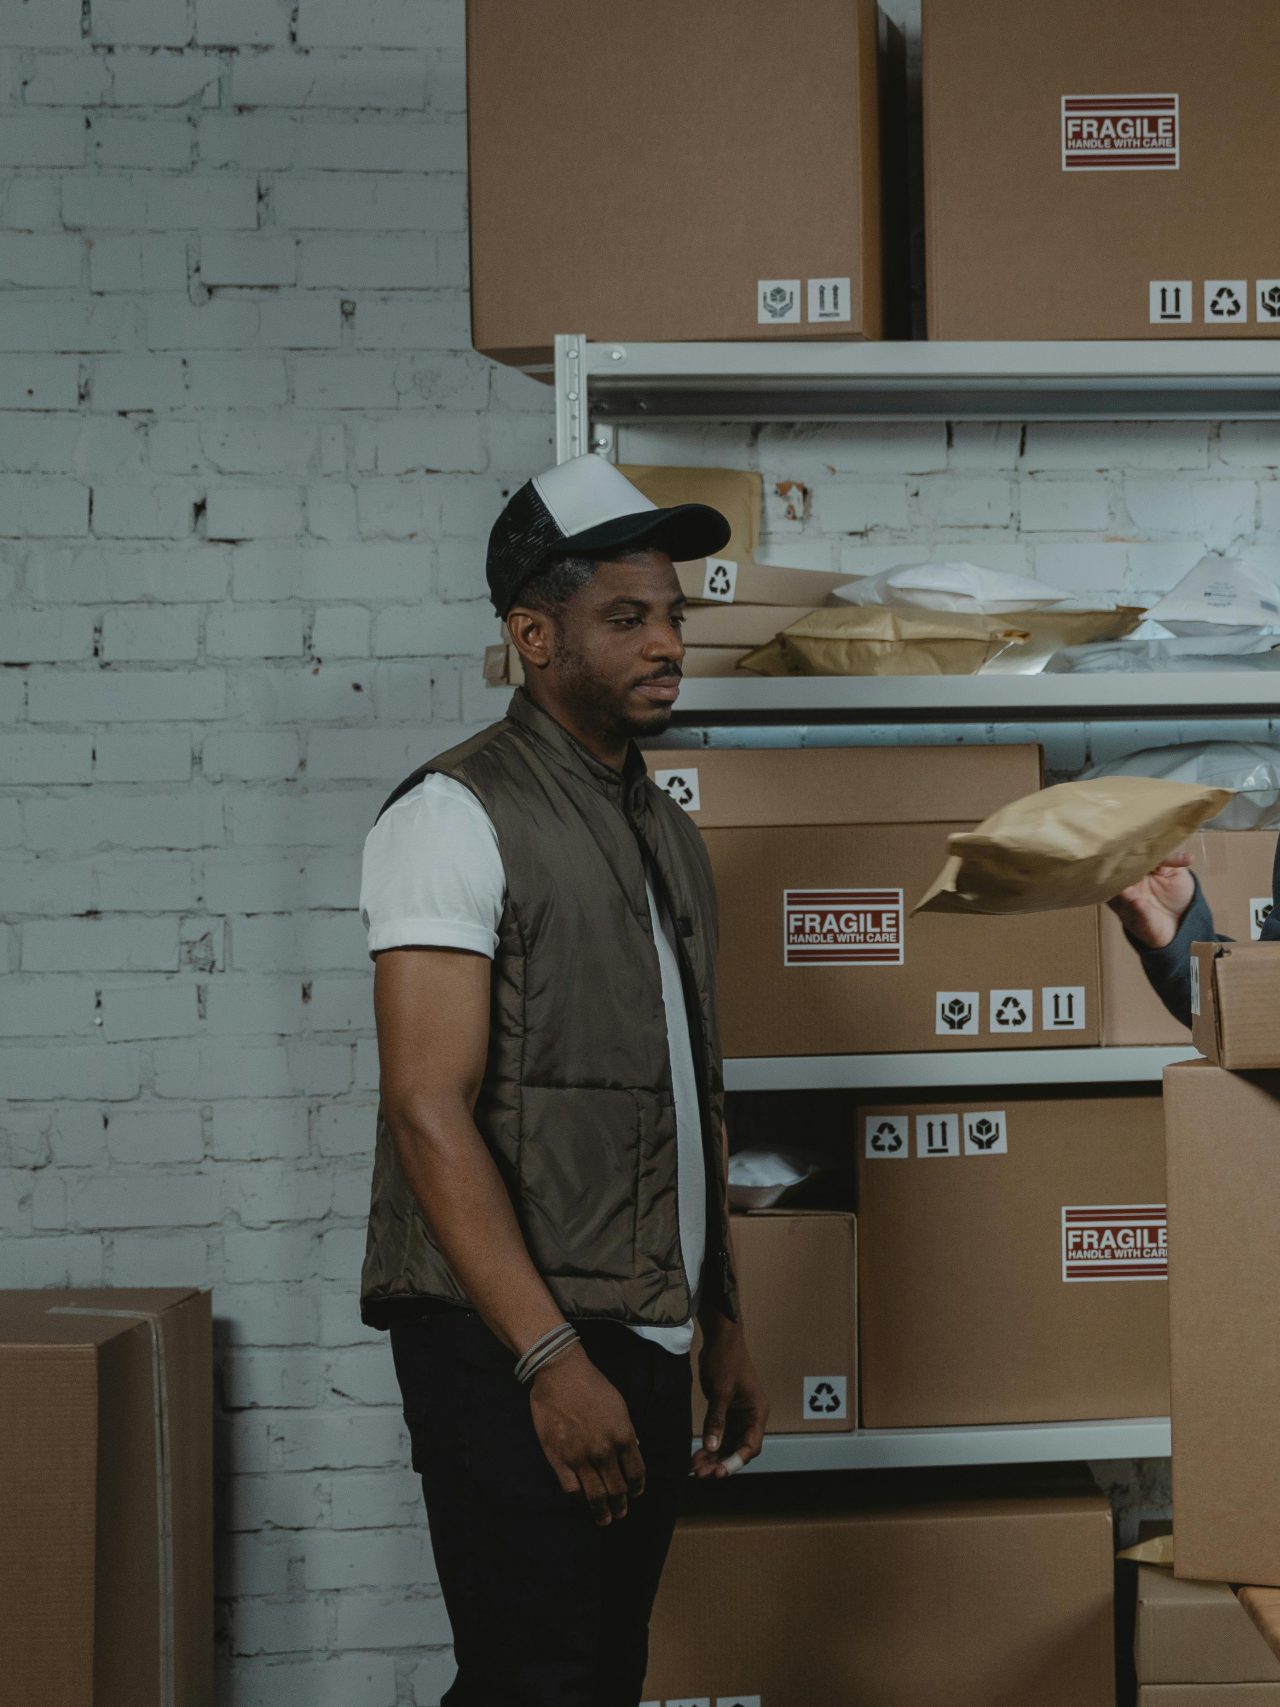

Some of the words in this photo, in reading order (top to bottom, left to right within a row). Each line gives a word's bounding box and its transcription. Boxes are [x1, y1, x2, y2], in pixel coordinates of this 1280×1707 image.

[1067, 118, 1173, 139] FRAGILE
[1068, 138, 1111, 149] HANDLE
[1114, 138, 1140, 148] WITH
[1143, 138, 1173, 147] CARE
[789, 913, 897, 934] FRAGILE
[789, 934, 834, 944] HANDLE
[836, 934, 864, 943] WITH
[866, 933, 897, 943] CARE
[1068, 1249, 1112, 1260] HANDLE
[1114, 1248, 1141, 1258] WITH
[1143, 1248, 1168, 1257] CAR
